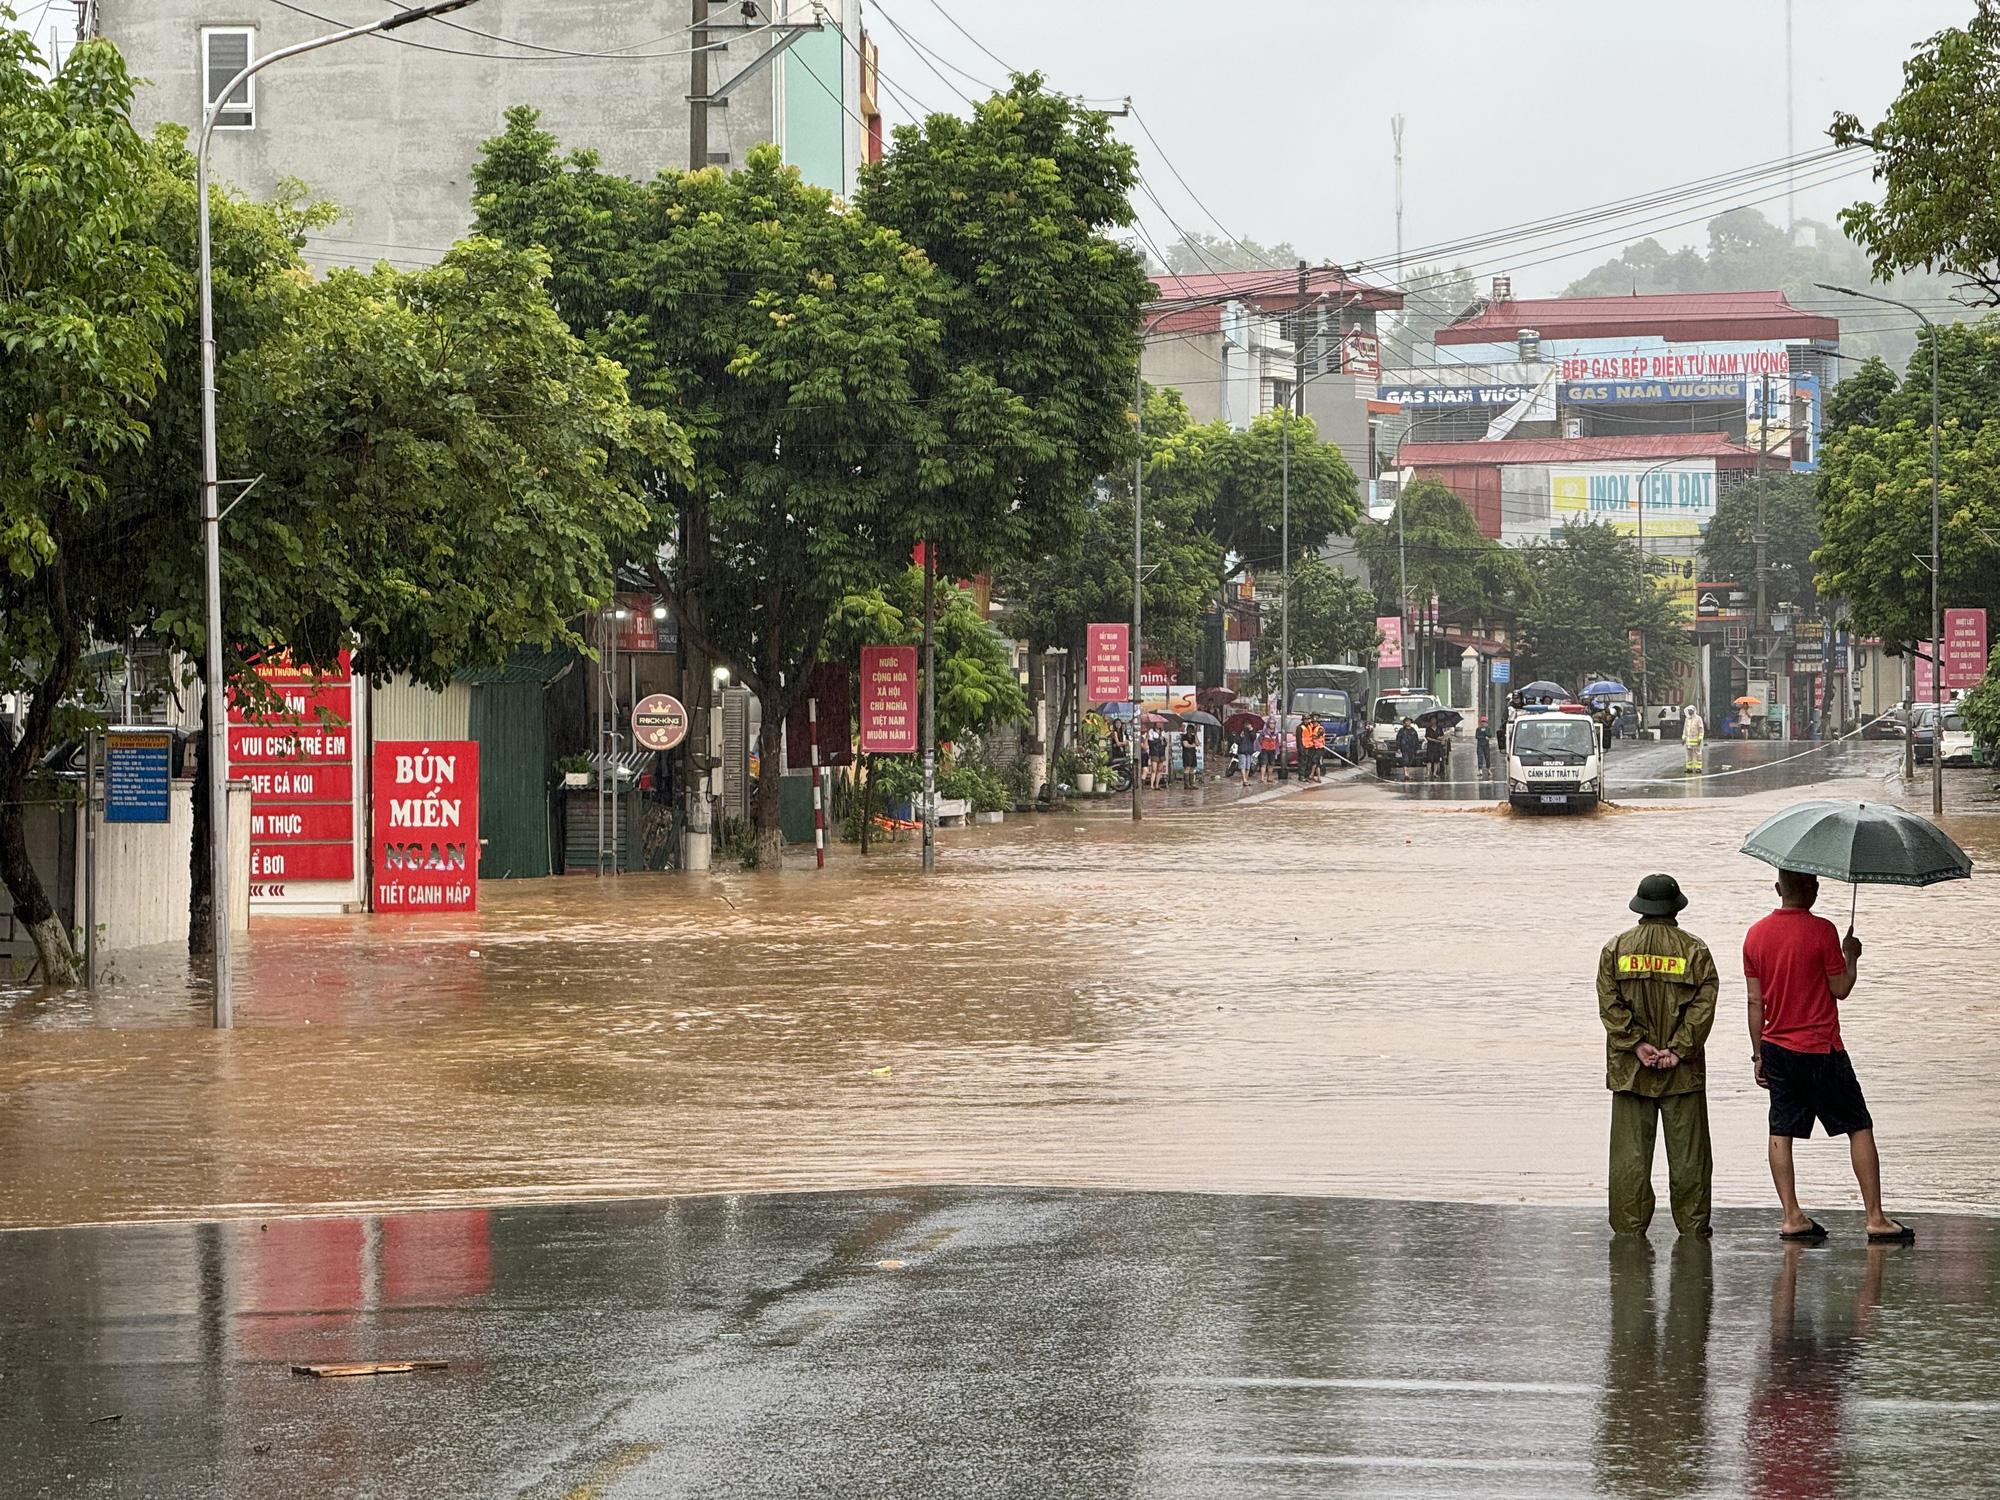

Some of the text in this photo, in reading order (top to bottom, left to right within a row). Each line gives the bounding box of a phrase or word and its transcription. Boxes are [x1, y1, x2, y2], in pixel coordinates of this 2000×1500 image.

[1563, 348, 1588, 380] BẾP
[1592, 357, 1619, 379] GAS
[1622, 346, 1648, 378] BẾP
[1709, 353, 1738, 375] NAM
[1386, 390, 1426, 404] GAS
[1428, 389, 1474, 403] NAM
[1568, 386, 1608, 400] GAS
[1616, 385, 1662, 399] NAM
[1590, 468, 1712, 513] INOX TIẾN ĐẠT
[879, 657, 898, 668] NƯỚC
[258, 666, 273, 677] TÂM
[872, 671, 908, 684] CỘNG HÒA
[877, 685, 900, 698] XÃ HỘI
[870, 698, 908, 711] CHỦ NGHĨA
[872, 714, 905, 727] VIỆT NAM
[241, 736, 262, 756] VUI
[299, 729, 323, 756] TRẺ
[325, 736, 346, 756] EM
[867, 729, 888, 740] MUÔN
[889, 729, 906, 740] NĂM
[395, 747, 456, 784] BÚN
[1527, 767, 1544, 778] CẢNH
[1544, 768, 1556, 778] SÁT
[1572, 768, 1580, 780] TỰ
[274, 771, 290, 793] CÁ
[293, 775, 313, 793] KOI
[389, 786, 461, 827] MIẾN
[267, 813, 302, 838] THỰC
[263, 855, 285, 875] BƠI
[383, 842, 467, 871] NGAN
[379, 878, 471, 905] TIẾT CANH HẤP
